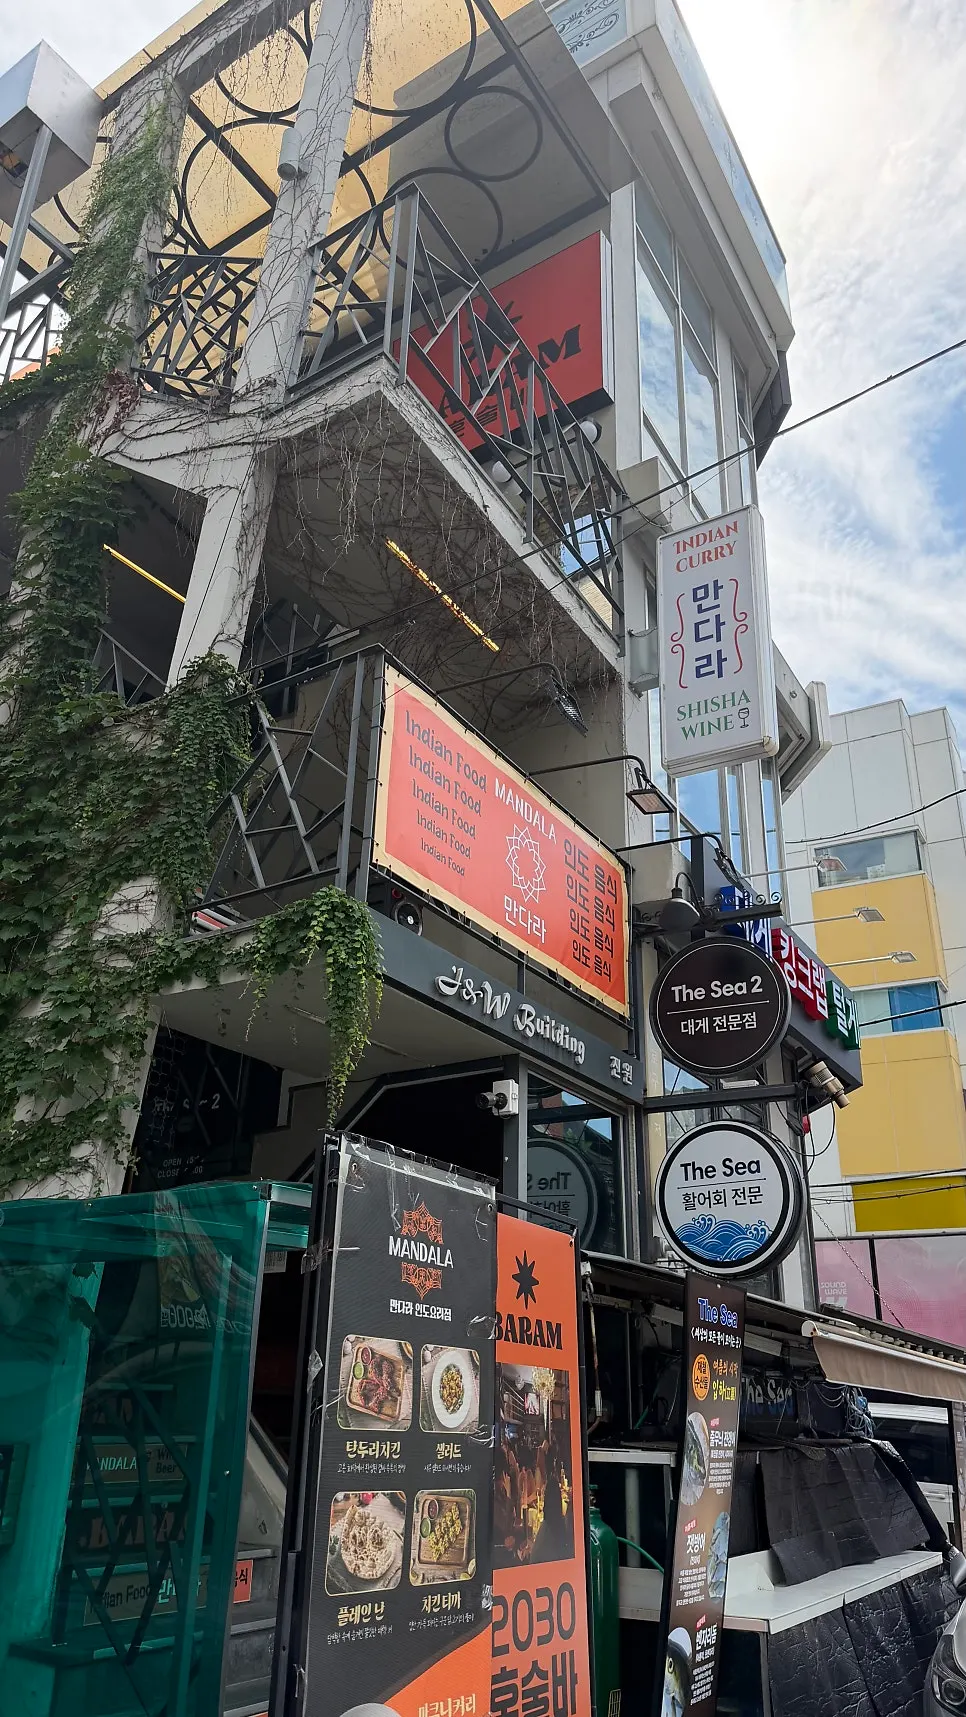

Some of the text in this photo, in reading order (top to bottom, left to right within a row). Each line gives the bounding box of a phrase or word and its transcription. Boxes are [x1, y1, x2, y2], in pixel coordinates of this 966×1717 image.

[673, 520, 739, 555] INDIAN
[675, 540, 737, 573] CURRY
[692, 579, 728, 679] 만다라
[676, 689, 751, 721] SHISHA
[681, 714, 735, 741] WINE
[405, 710, 487, 793] Indian Food
[408, 745, 482, 816] Indian Food
[412, 779, 476, 840] Indian Food
[494, 777, 558, 845] MANDALA
[416, 809, 471, 860] Indian Food
[420, 837, 465, 876] Indian Food
[563, 838, 618, 904] 인도 음식
[504, 895, 547, 944] 만다라
[566, 873, 615, 932] 인도 음식
[569, 908, 614, 958] 인도 음식
[572, 939, 612, 982] 인도 음식
[671, 975, 763, 1003] The Sea 2
[513, 1003, 586, 1065] Building
[681, 1011, 757, 1036] 대게 전문점
[831, 981, 861, 1049] 털게
[680, 1156, 762, 1182] The Sea
[682, 1186, 764, 1211] 활어회 전문
[388, 1235, 454, 1268] MANDALA
[389, 1299, 452, 1322] 만다라 인도요리점
[697, 1297, 739, 1329] The Sea
[345, 1440, 401, 1460] 탄두리치킨
[686, 1532, 706, 1553] 잿방어
[337, 1601, 386, 1627] 플레인 난
[491, 1582, 576, 1658] 2030
